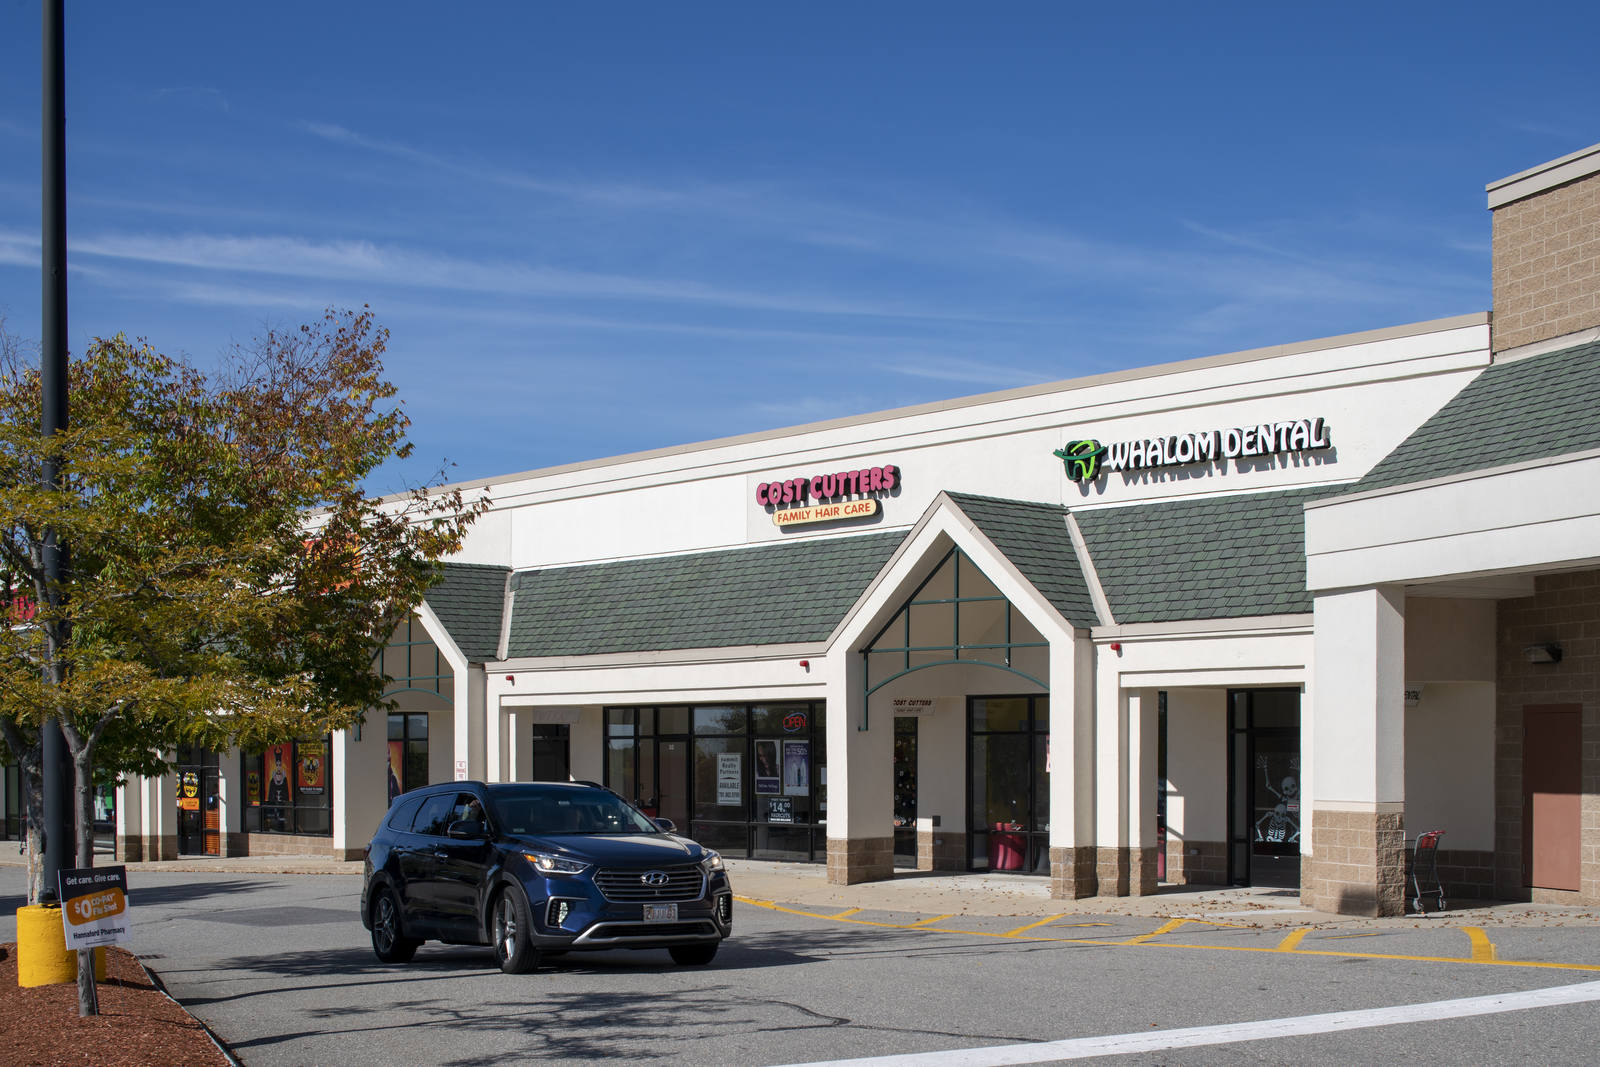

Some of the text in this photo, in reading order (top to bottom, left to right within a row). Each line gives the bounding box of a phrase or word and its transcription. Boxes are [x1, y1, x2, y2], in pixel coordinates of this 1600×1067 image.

[1107, 417, 1329, 471] WHALOM DENTAL
[756, 464, 897, 506] COST CUTTERS
[777, 502, 871, 523] FAMILY HAIR CARE
[783, 716, 806, 728] OPEN
[66, 877, 77, 885] Get
[94, 874, 107, 883] Give
[103, 902, 118, 912] Shot
[73, 927, 125, 939] Hannaford Pharmacy
